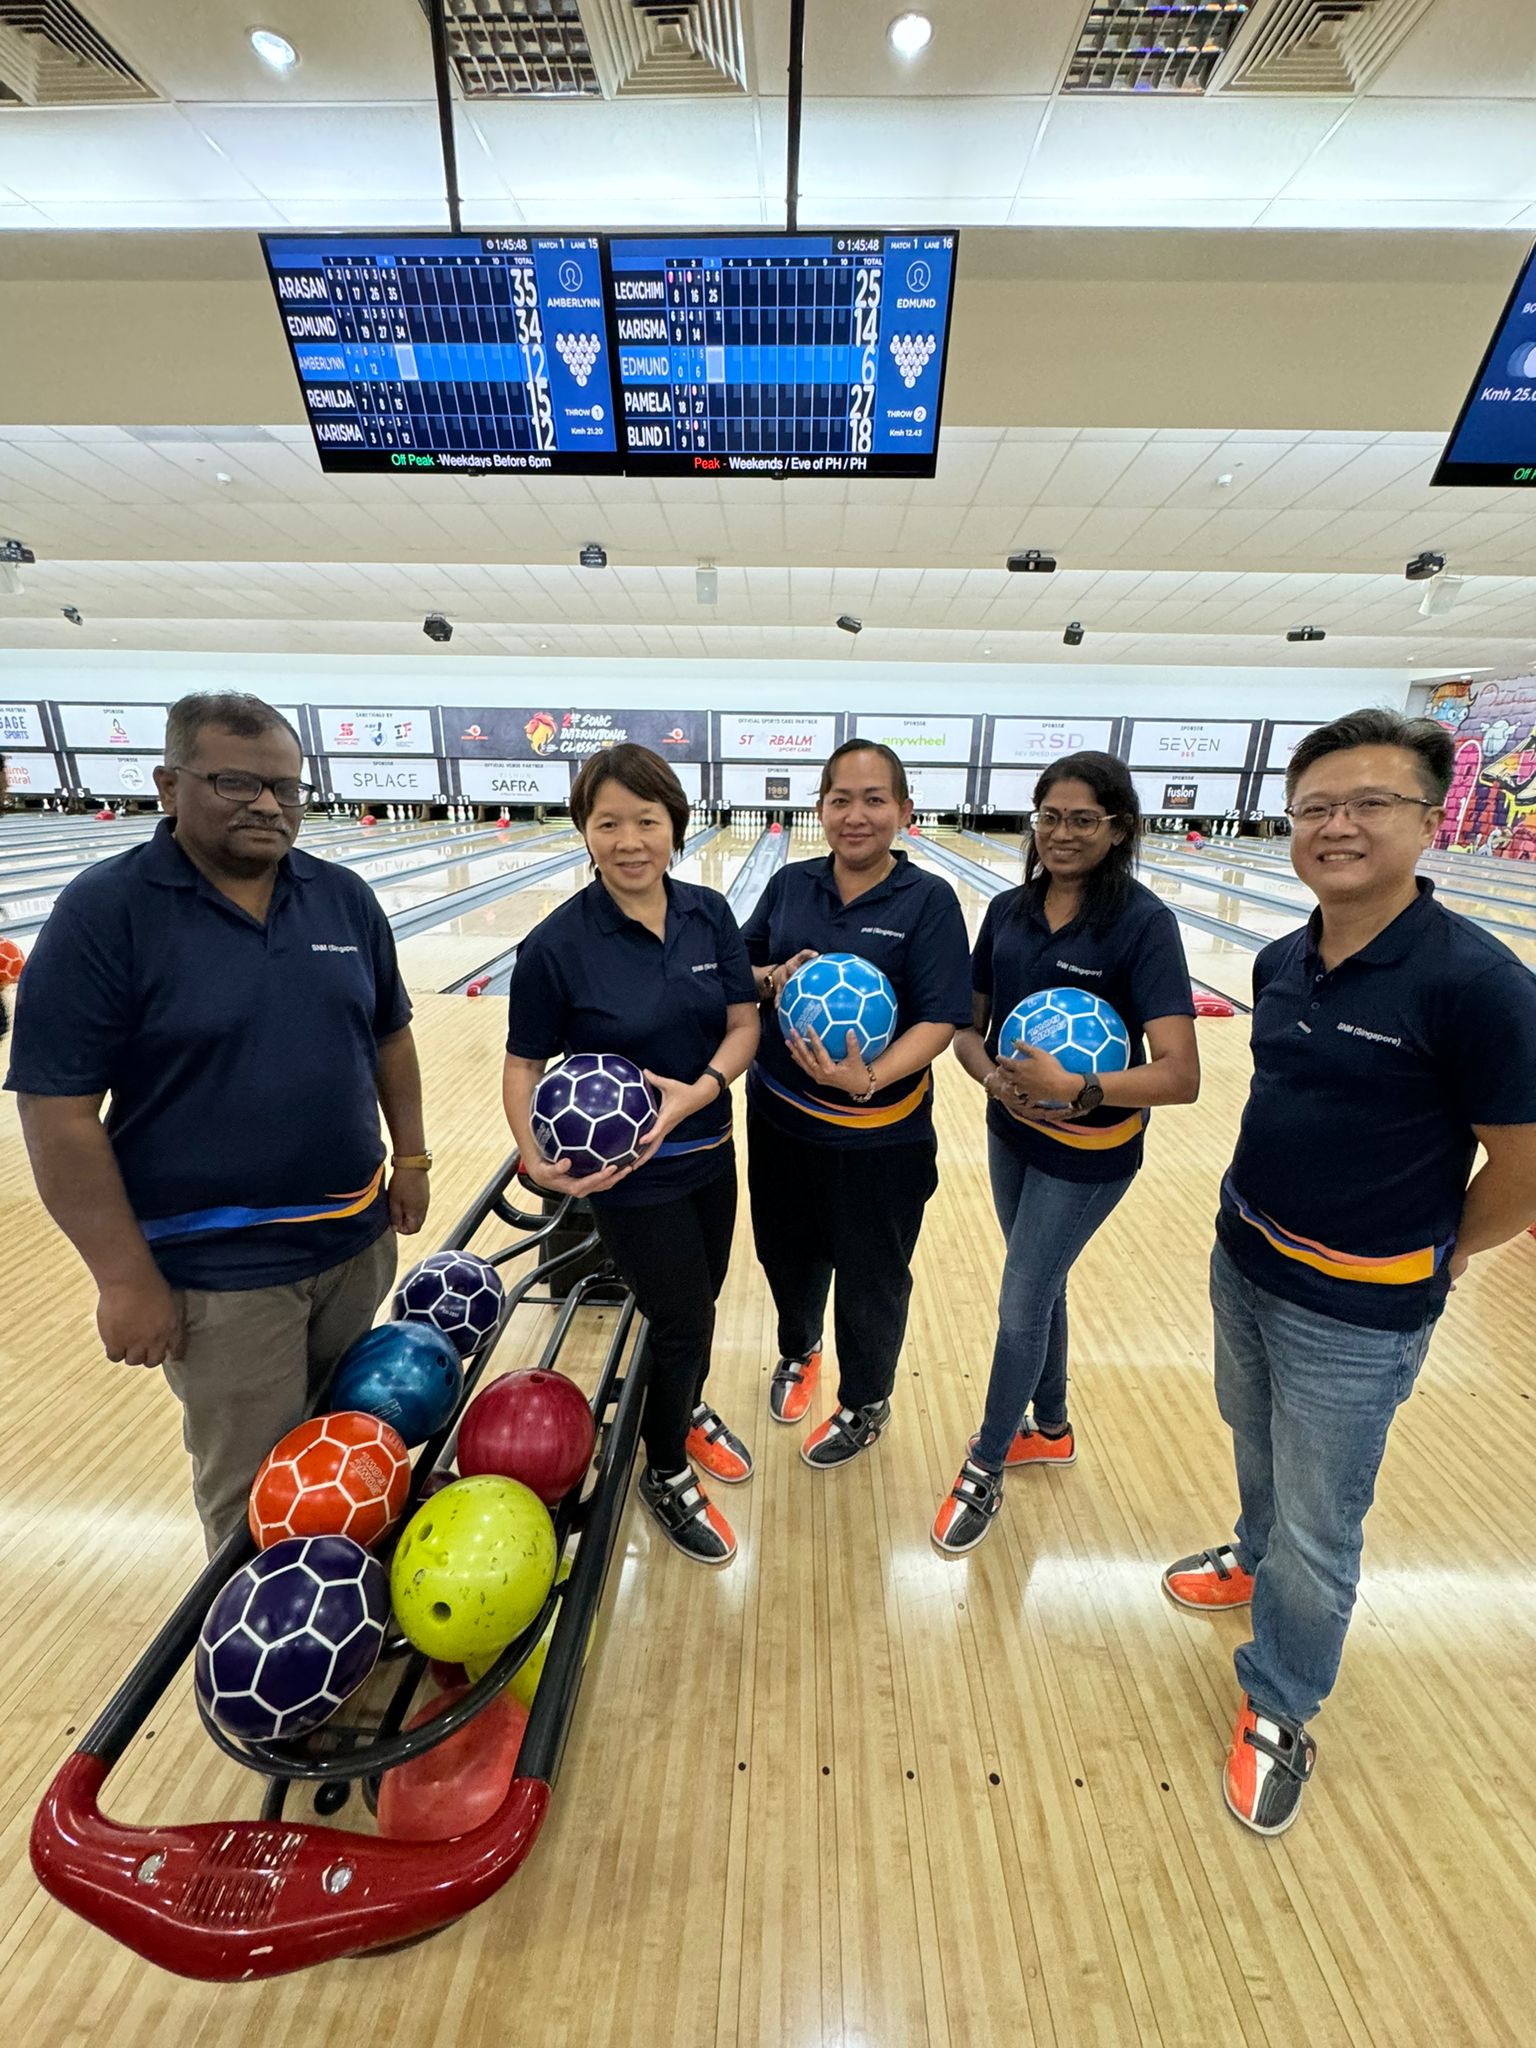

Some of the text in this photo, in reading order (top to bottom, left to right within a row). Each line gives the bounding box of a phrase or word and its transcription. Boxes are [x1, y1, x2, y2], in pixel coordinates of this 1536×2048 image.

[495, 239, 528, 251] 1:45:48
[538, 238, 598, 249] MATCH 1 LANE 15
[846, 239, 880, 251] 1:45:48
[913, 239, 918, 249] 1
[924, 241, 940, 249] LANE
[942, 238, 953, 249] 16
[492, 257, 500, 265] 10
[514, 257, 534, 265] TOTAL
[863, 258, 883, 266] TOTAL
[278, 276, 328, 299] ARASAN
[336, 268, 538, 308] 8 17 26 35 35
[614, 281, 665, 300] LECKCHIMI
[674, 269, 881, 308] 8 16 25 25
[547, 298, 600, 308] AMBERLYNN
[896, 299, 936, 309] EDMUND
[286, 316, 337, 337] EDMUND
[345, 308, 542, 344] 1 19 27 34 34
[618, 319, 667, 340] KARISMA
[676, 308, 878, 347] 9 14 14
[299, 357, 346, 371] AMBERLYNN
[355, 344, 548, 381] 4 12 12
[622, 357, 669, 377] EDMUND
[678, 345, 876, 384] 0 6 6
[306, 389, 355, 408] REMILDA
[362, 380, 551, 417] 7 8 15 15
[1481, 387, 1511, 401] Kmh
[624, 392, 672, 412] PAMELA
[679, 384, 875, 419] 18 27 27
[564, 409, 591, 417] THROW
[887, 410, 913, 418] THROW
[316, 424, 364, 441] KARISMA
[370, 417, 557, 450] 3 9 12 12
[627, 426, 670, 446] BLIND 1
[681, 418, 872, 453] 9 18 18
[391, 454, 552, 469] Off Peak -Weekdays Before 6pm
[694, 457, 720, 469] Peak
[729, 457, 783, 470] Weekends
[790, 458, 811, 470] Eve
[812, 457, 824, 470] of
[825, 457, 842, 470] PH
[850, 457, 867, 470] PH
[1514, 468, 1531, 481] Off
[580, 714, 612, 728] SONIC
[4, 730, 29, 740] SPORTS
[560, 728, 628, 741] INTERNATIONAL
[882, 733, 946, 747] anywheel
[1025, 732, 1084, 749] RSD
[560, 741, 602, 753] CLASSIC
[1159, 738, 1221, 752] SEVEN
[353, 772, 419, 788] SPLACE
[492, 780, 540, 791] SAFRA
[61, 788, 69, 798] 4
[77, 788, 85, 798] 5
[312, 792, 320, 802] 8
[328, 792, 335, 802] 9
[767, 786, 788, 795] 1989
[1167, 785, 1196, 798] fusion
[433, 794, 448, 804] 10
[457, 795, 469, 805] 11
[693, 800, 707, 809] 14
[717, 800, 730, 810] 15
[958, 804, 971, 814] 18
[981, 804, 994, 814] 19
[1225, 810, 1241, 820] 22
[1249, 811, 1264, 821] 23
[1353, 1027, 1401, 1047] (Singapore)
